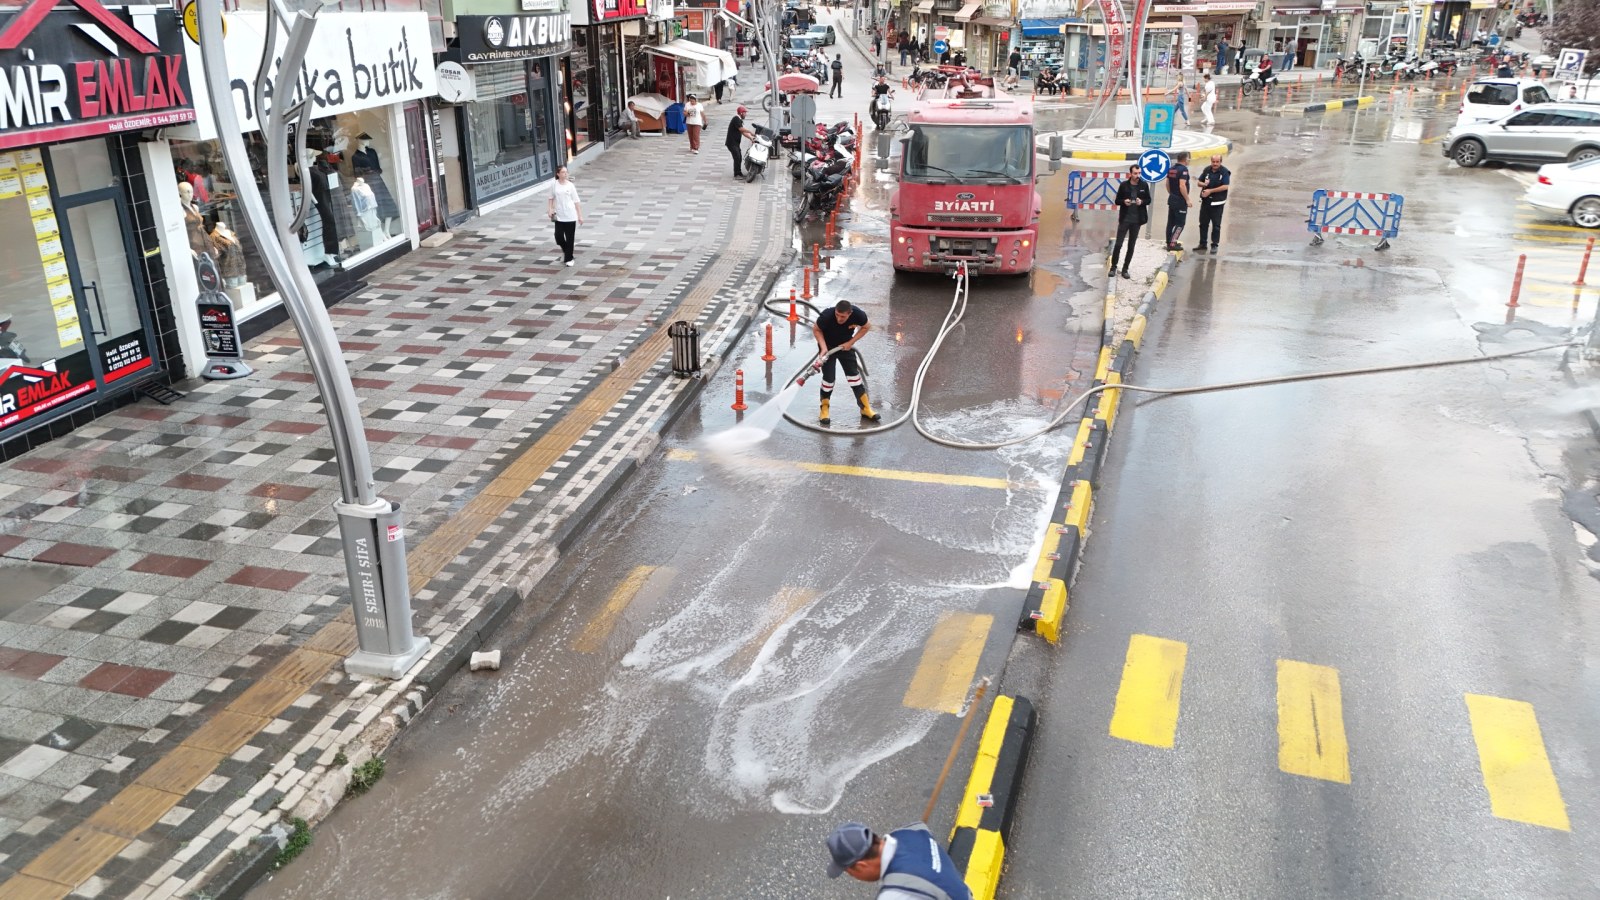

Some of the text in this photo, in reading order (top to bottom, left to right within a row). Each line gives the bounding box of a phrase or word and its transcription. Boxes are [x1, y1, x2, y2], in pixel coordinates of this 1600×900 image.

[508, 14, 571, 47] AKBULUT
[346, 25, 423, 100] butik
[468, 49, 531, 60] GAYRİMENKUL
[1183, 33, 1195, 70] KASAP
[1561, 52, 1579, 69] P
[75, 54, 188, 118] EMLAK
[1149, 109, 1168, 131] P
[17, 370, 72, 407] EMLAK
[355, 537, 371, 568] ŞİFA
